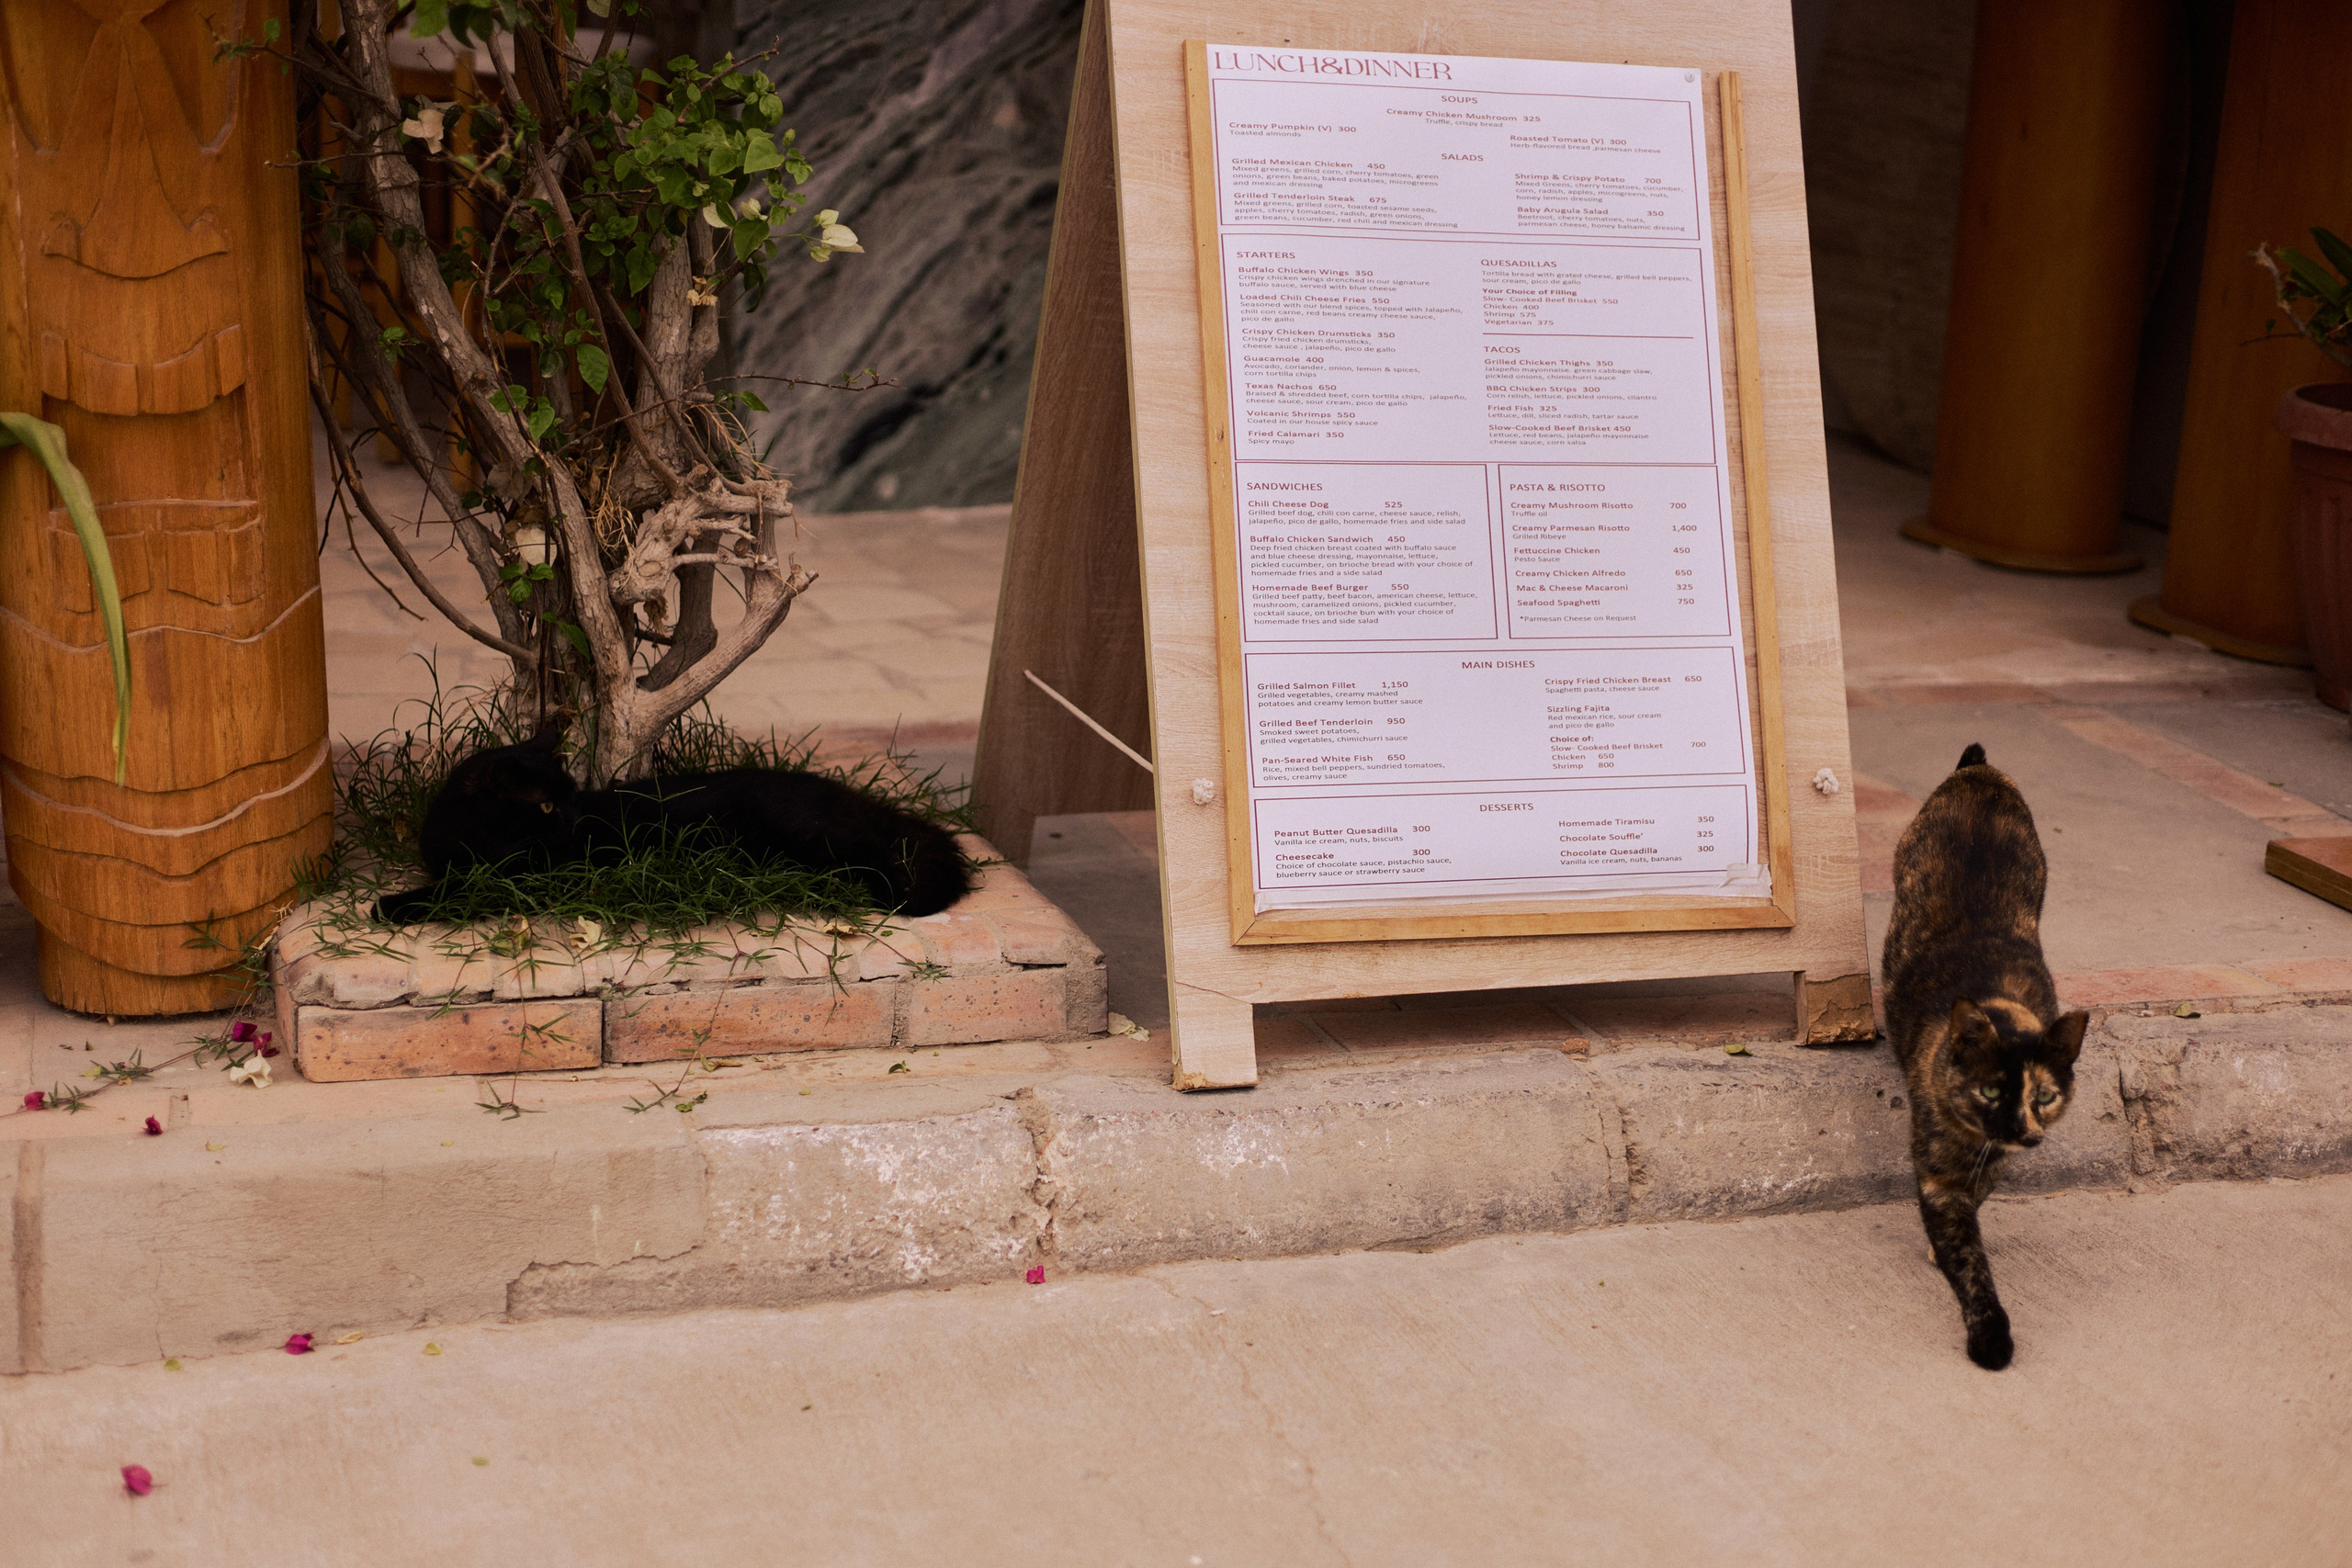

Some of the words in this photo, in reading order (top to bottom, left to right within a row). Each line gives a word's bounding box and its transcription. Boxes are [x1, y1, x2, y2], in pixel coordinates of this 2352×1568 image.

[1215, 51, 1452, 80] LUNCH&DINNER
[1441, 95, 1477, 104] SOUPS
[1386, 108, 1422, 117] Creamy
[1441, 152, 1484, 162] SALADS
[1237, 251, 1295, 259] STARTERS
[1480, 259, 1556, 267] QUESADILLAS
[1318, 268, 1349, 276] Wings
[1483, 345, 1521, 354] TACOS
[1247, 481, 1323, 491] SANDWICHES
[1510, 483, 1544, 491] PASTA
[1547, 483, 1555, 491] &
[1559, 483, 1605, 491] RISOTTO
[1309, 501, 1329, 509] Dog
[1510, 502, 1545, 510] Creamy
[1250, 535, 1284, 543] Buffalo
[1515, 570, 1550, 578] Creamy
[1336, 583, 1368, 592] Burger
[1462, 660, 1492, 669] MAIN
[1496, 660, 1535, 669] DISHES
[1293, 682, 1329, 690] Salmon
[1382, 681, 1408, 689] 1,150
[1584, 705, 1610, 713] Fajita
[1259, 719, 1292, 728] Grilled
[1295, 718, 1317, 727] Beef
[1261, 756, 1318, 764] Pan-Seared
[1479, 802, 1533, 812] DESSERTS
[1558, 818, 1612, 827] Homemade
[1346, 826, 1397, 835] Quesadilla
[1275, 852, 1334, 861] Cheesecake
[1412, 848, 1430, 856] 300
[1560, 849, 1607, 857] Chocolate
[1609, 847, 1657, 855] Quesadilla
